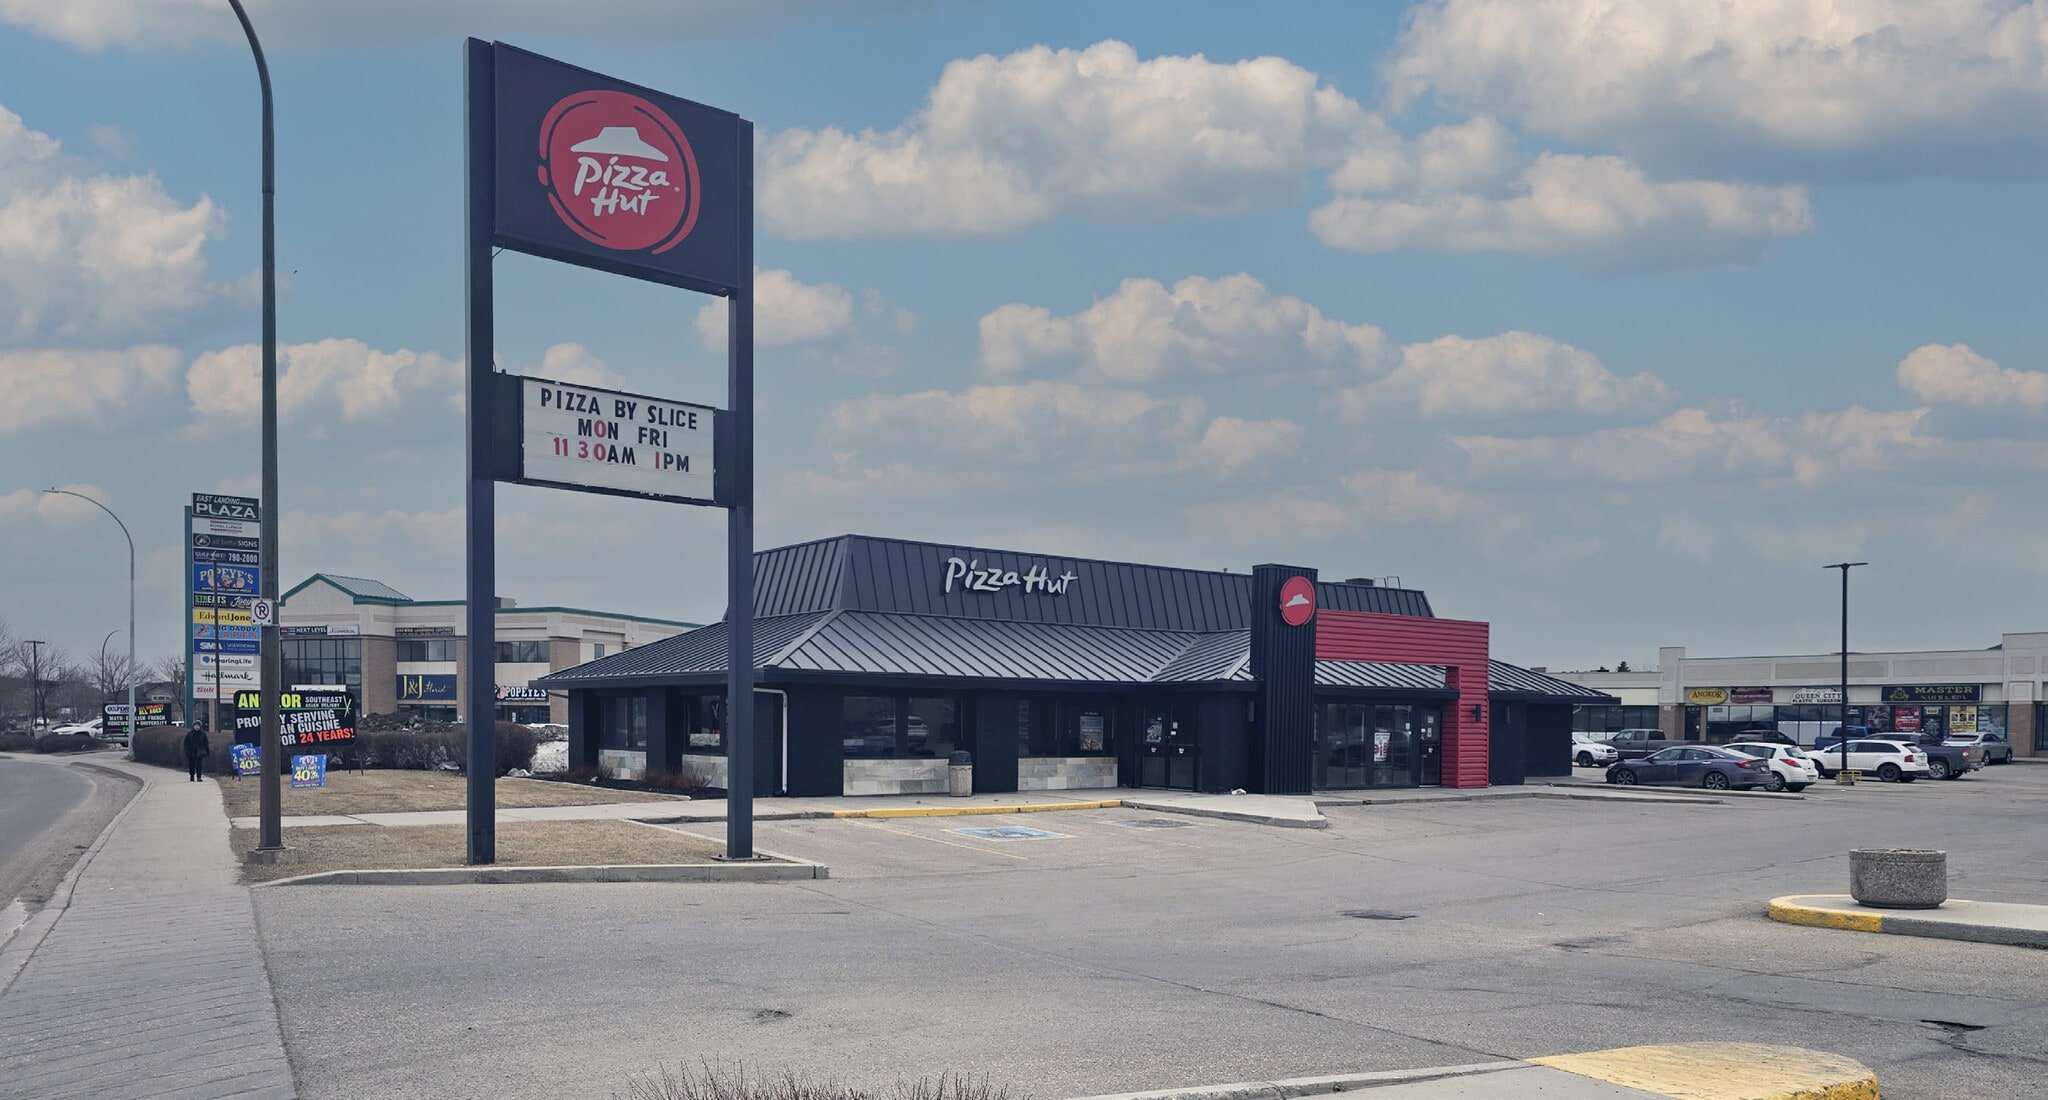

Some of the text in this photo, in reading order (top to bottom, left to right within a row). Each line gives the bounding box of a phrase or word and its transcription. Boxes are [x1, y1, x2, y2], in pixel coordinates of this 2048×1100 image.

[574, 156, 670, 196] Pizza
[591, 187, 660, 217] Hut
[541, 388, 697, 430] PIZZA BY SLICE
[578, 418, 667, 448] MON FRI
[655, 451, 689, 472] 1PM
[214, 496, 240, 505] LANDING
[196, 503, 256, 518] PLAZA
[237, 540, 258, 548] SIGNS
[945, 557, 1078, 594] Pizza Hut
[199, 612, 251, 622] Edwrd Jone
[215, 631, 258, 640] APES
[210, 656, 252, 665] HaringLife
[201, 670, 254, 682] Halmark
[401, 675, 423, 699] J&J
[1914, 686, 1973, 694] MASTER
[238, 693, 302, 708] ANOR
[1795, 692, 1820, 700] QUEEN
[290, 709, 335, 724] SERVING
[297, 719, 341, 733] CUISINE
[281, 727, 355, 746] OR 24 YEARS!
